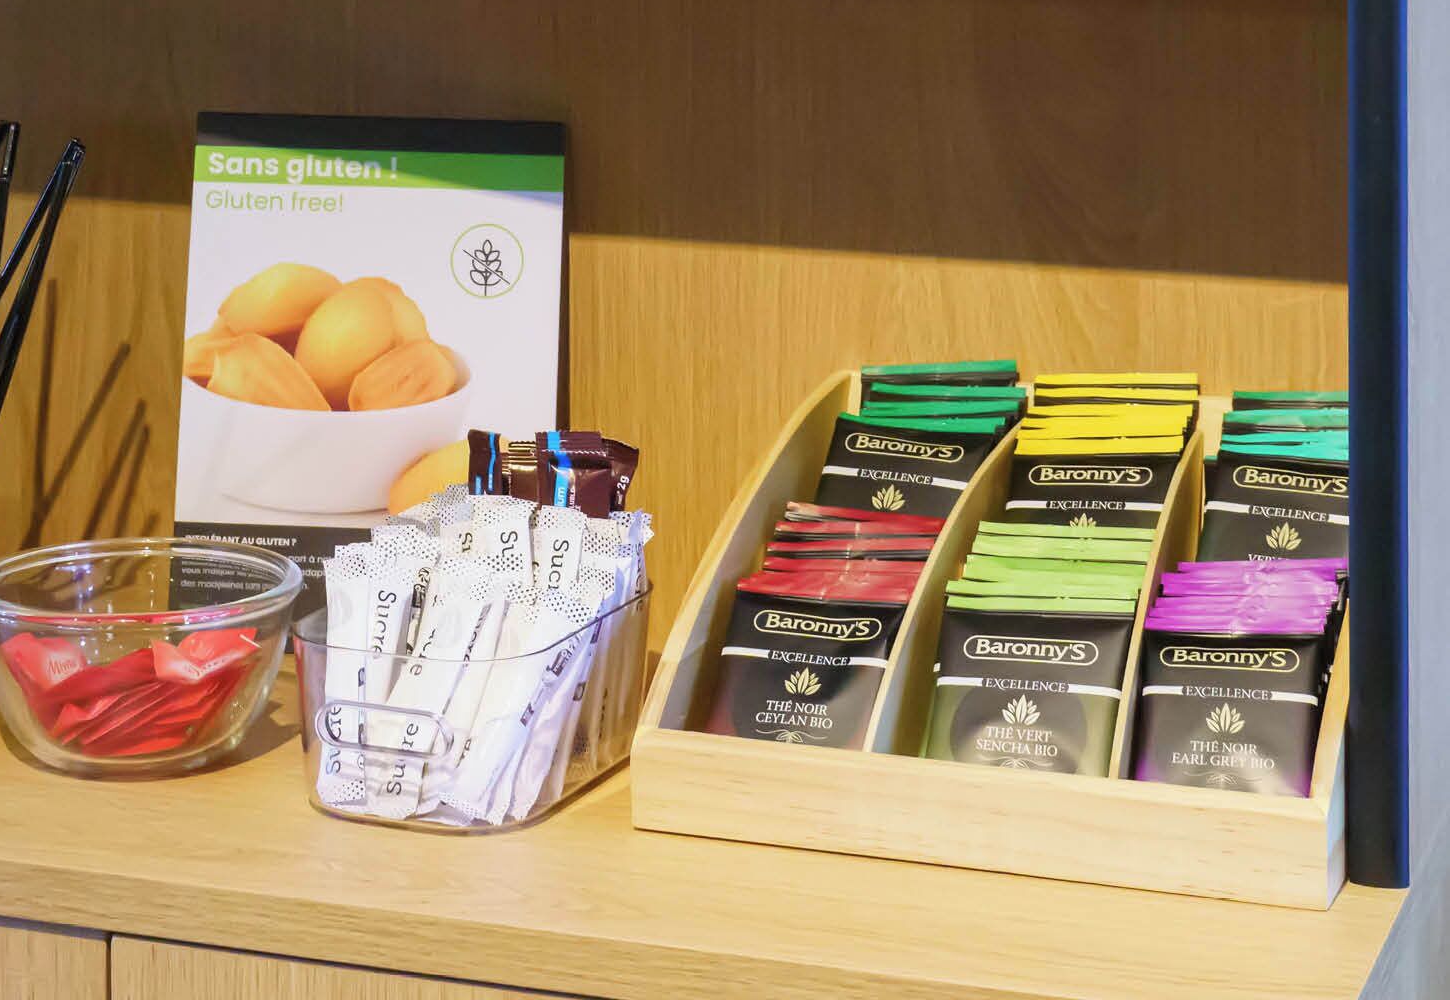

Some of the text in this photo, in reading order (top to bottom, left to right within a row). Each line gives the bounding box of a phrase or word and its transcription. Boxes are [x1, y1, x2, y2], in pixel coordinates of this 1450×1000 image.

[208, 152, 398, 184] Sans gluten !
[205, 190, 344, 213] Gluten free!
[617, 475, 630, 490] 2g
[860, 468, 931, 486] EXCELLENCE
[1049, 499, 1124, 511] EXCELLENCE
[1251, 504, 1327, 522] EXCELLENCE
[242, 537, 254, 545] AU
[256, 537, 292, 546] GLUTEN
[372, 589, 397, 659] Sucre
[771, 649, 850, 667] EXCELLENCE
[985, 677, 1067, 693] EXCELLENCE
[1185, 684, 1270, 700] EXCELLENCE
[766, 698, 828, 716] THÉ NOIR
[755, 711, 833, 730] CEYLAN BIO
[987, 723, 1052, 742] THÉ VERT
[976, 738, 1058, 758] SENCHA BIO
[1190, 738, 1258, 756] THÉ NOIR
[386, 722, 419, 796] Sure
[1172, 751, 1275, 770] EARL GREY BIO
